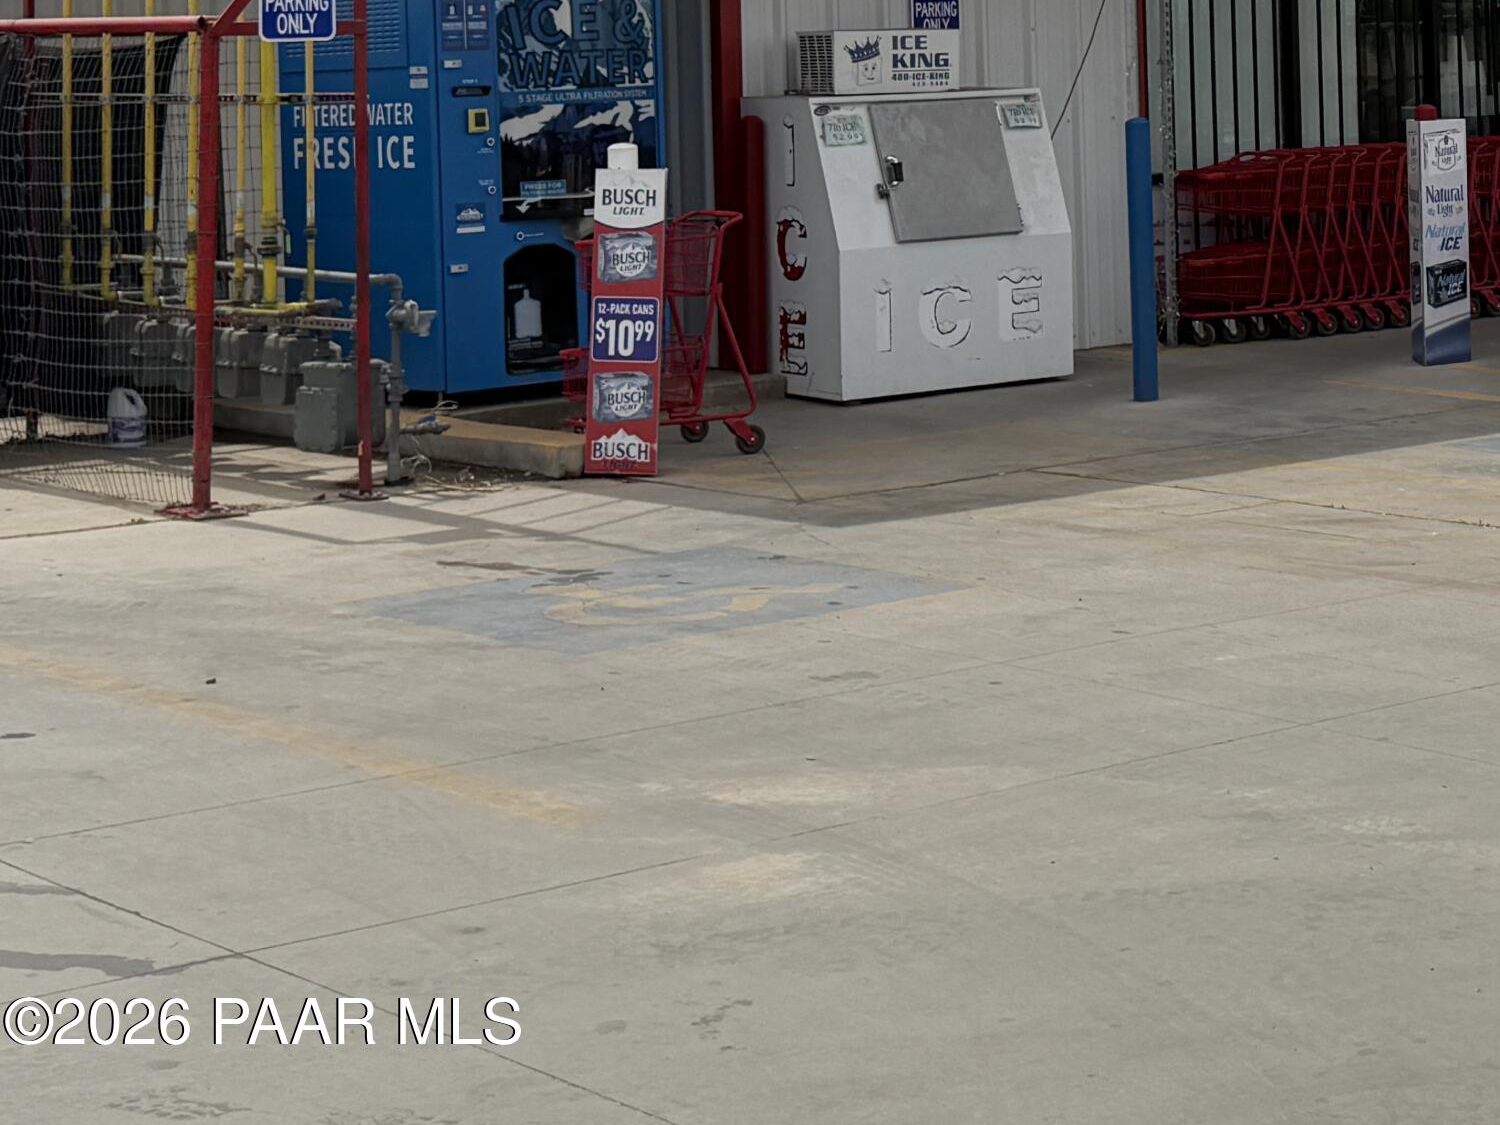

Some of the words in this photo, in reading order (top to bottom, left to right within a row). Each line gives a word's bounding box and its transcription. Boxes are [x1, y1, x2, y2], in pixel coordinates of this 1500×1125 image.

[915, 1, 957, 17] PARKING
[276, 13, 319, 35] ONLY
[891, 35, 928, 50] ICE
[891, 52, 950, 69] KING
[509, 48, 650, 90] WATER
[526, 92, 552, 103] STAGE
[555, 91, 582, 101] ULTRA
[293, 104, 356, 127] FITERED
[293, 136, 356, 170] FRES
[377, 136, 416, 169] ICE
[602, 188, 657, 207] BUSCH
[1425, 184, 1464, 204] Natural
[612, 207, 643, 216] LIGHT
[1437, 203, 1453, 218] Light
[1425, 221, 1466, 238] Natural
[1440, 236, 1463, 252] ICE
[612, 251, 650, 266] BUSCH
[620, 264, 642, 272] LIGHT
[1447, 281, 1464, 295] ICE
[598, 303, 630, 315] 12-PACK
[632, 303, 654, 315] CANS
[607, 391, 647, 406] BUSCH
[615, 403, 638, 412] LIGHT
[592, 441, 649, 460] BUSCH
